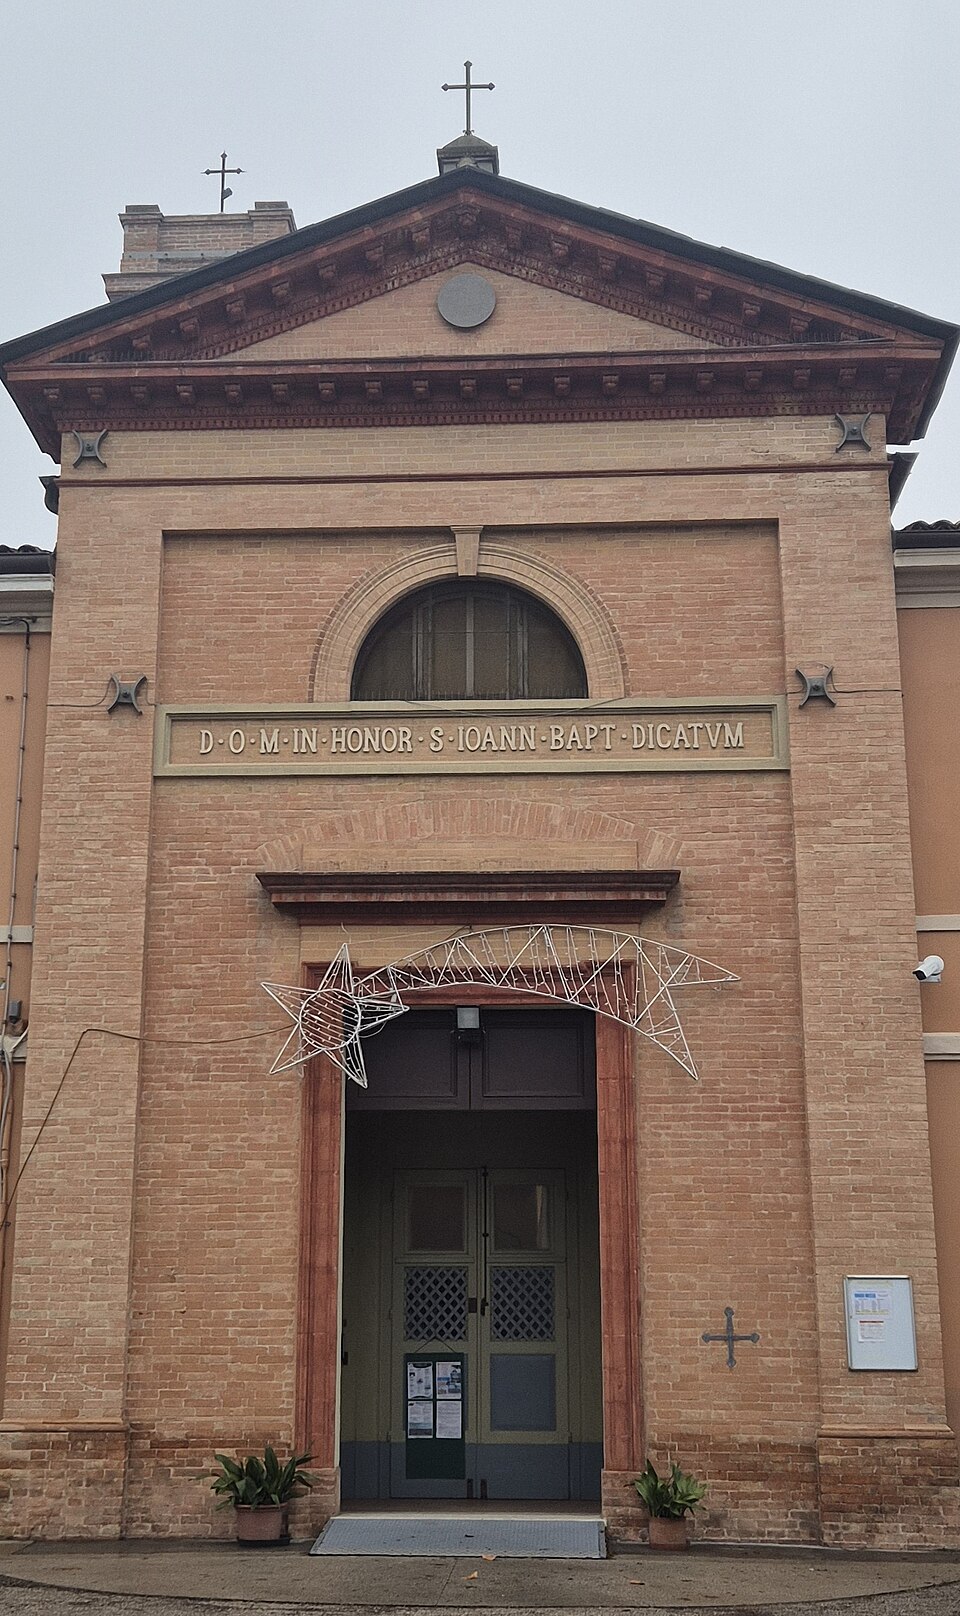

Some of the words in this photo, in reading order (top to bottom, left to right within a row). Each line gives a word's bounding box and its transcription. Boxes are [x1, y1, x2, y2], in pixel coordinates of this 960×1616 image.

[199, 729, 214, 754] D
[228, 728, 246, 754] O
[259, 728, 281, 754] M
[292, 727, 318, 754] IN
[330, 726, 413, 753] HONOR
[429, 726, 445, 752] S
[456, 725, 537, 752] IOANN
[549, 723, 617, 751] BAPT
[631, 722, 745, 750] DICATVM
